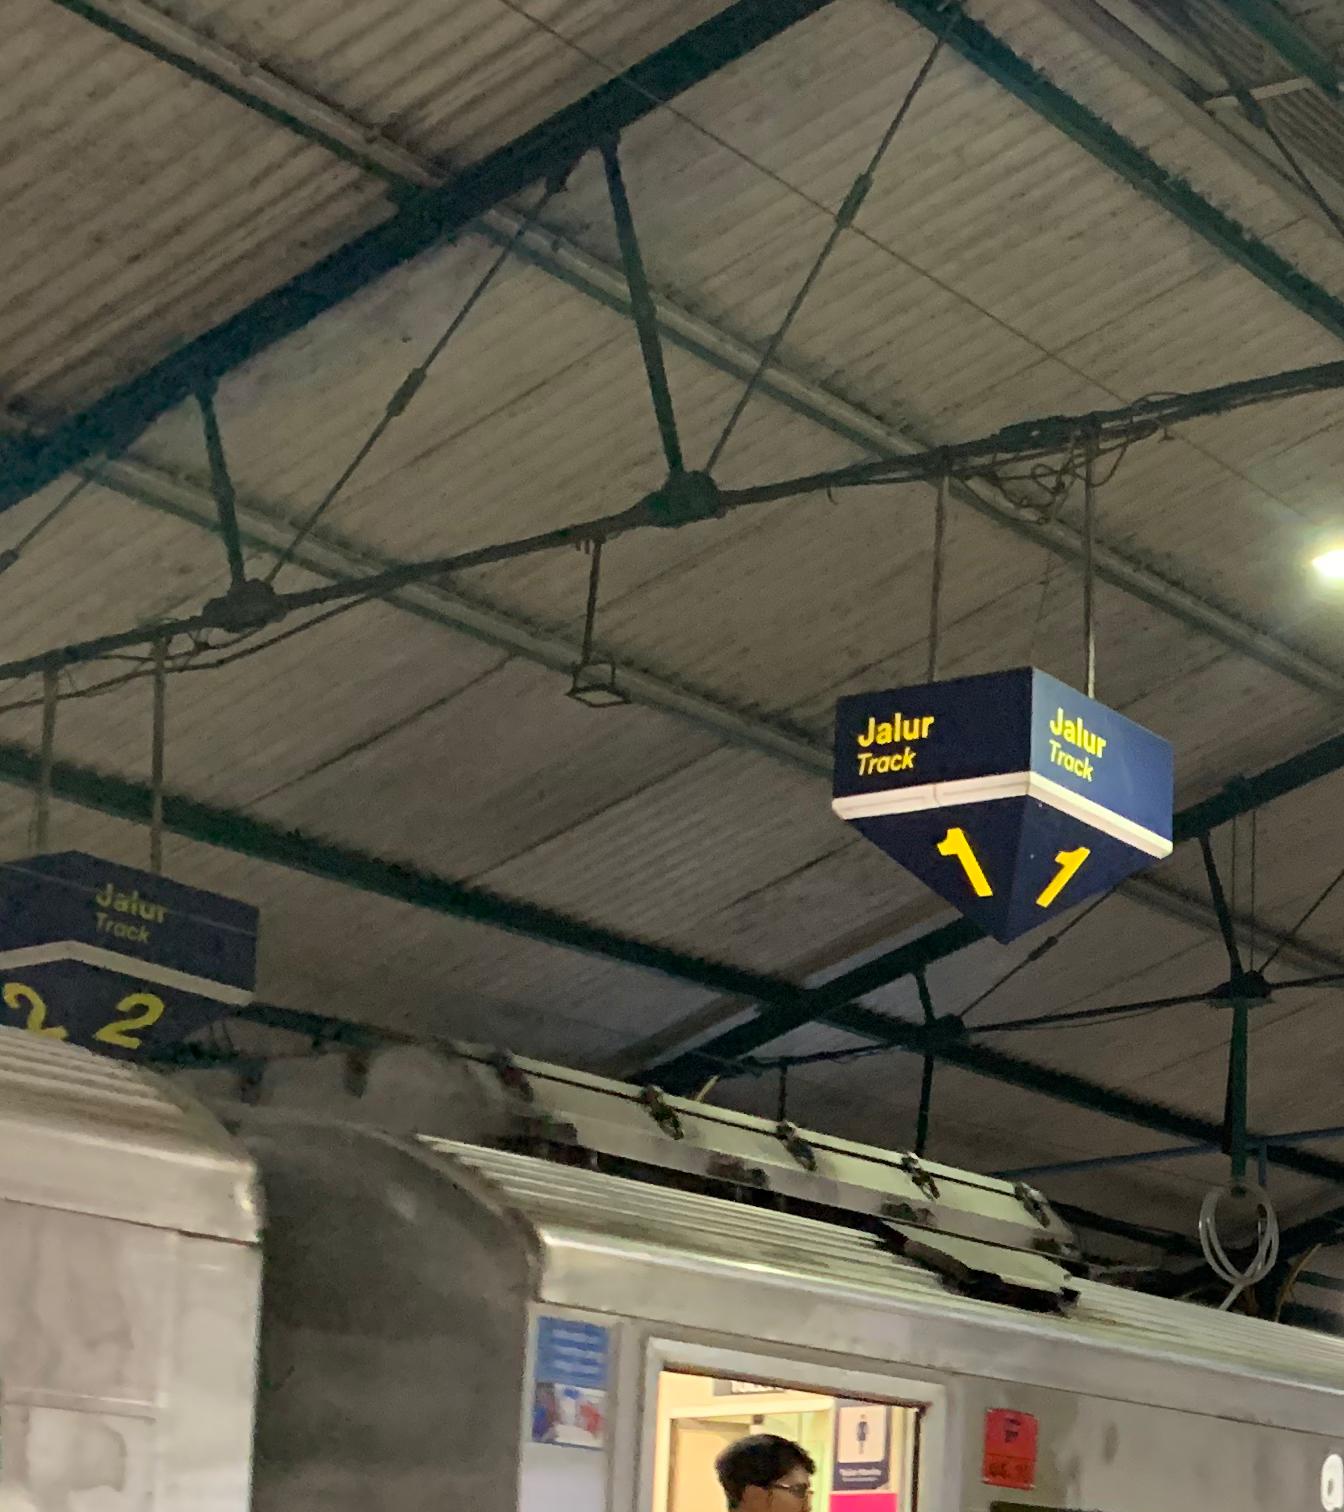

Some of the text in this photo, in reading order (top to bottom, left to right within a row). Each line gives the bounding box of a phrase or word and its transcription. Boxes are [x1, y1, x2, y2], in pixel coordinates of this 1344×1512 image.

[857, 713, 935, 748] Jalur
[1049, 707, 1107, 758] Jalur
[857, 747, 917, 776] Track
[1048, 740, 1094, 782] Track
[936, 827, 994, 897] 1
[1036, 846, 1092, 909] 1
[96, 883, 168, 924] Jalur
[96, 912, 150, 943] Track
[92, 992, 165, 1049] 2
